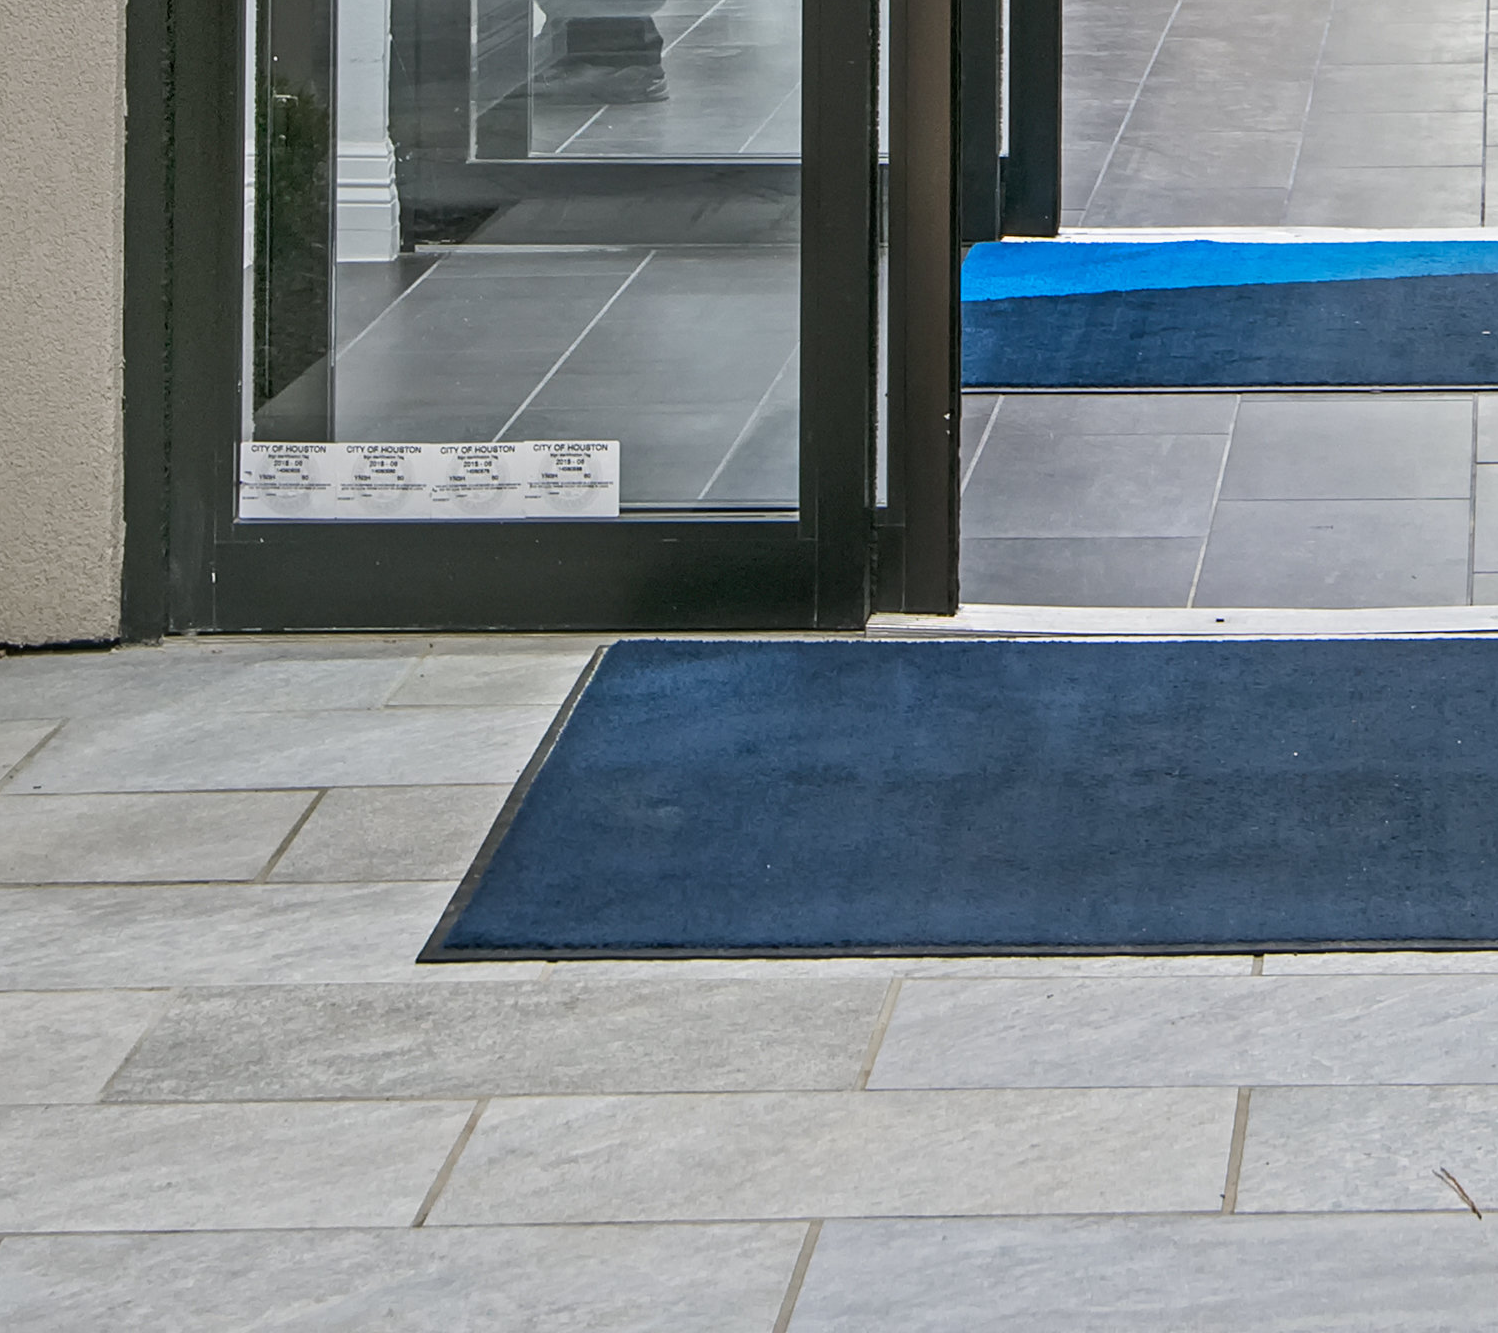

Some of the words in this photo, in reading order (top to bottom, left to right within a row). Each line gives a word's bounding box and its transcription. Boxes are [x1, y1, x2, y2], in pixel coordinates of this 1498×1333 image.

[251, 445, 271, 453] CITY
[272, 445, 283, 453] OF
[286, 445, 326, 453] HOUSTON
[346, 445, 365, 453] CITY
[367, 445, 379, 453] OF
[461, 446, 472, 454] OF
[475, 445, 515, 453] HOUSTON
